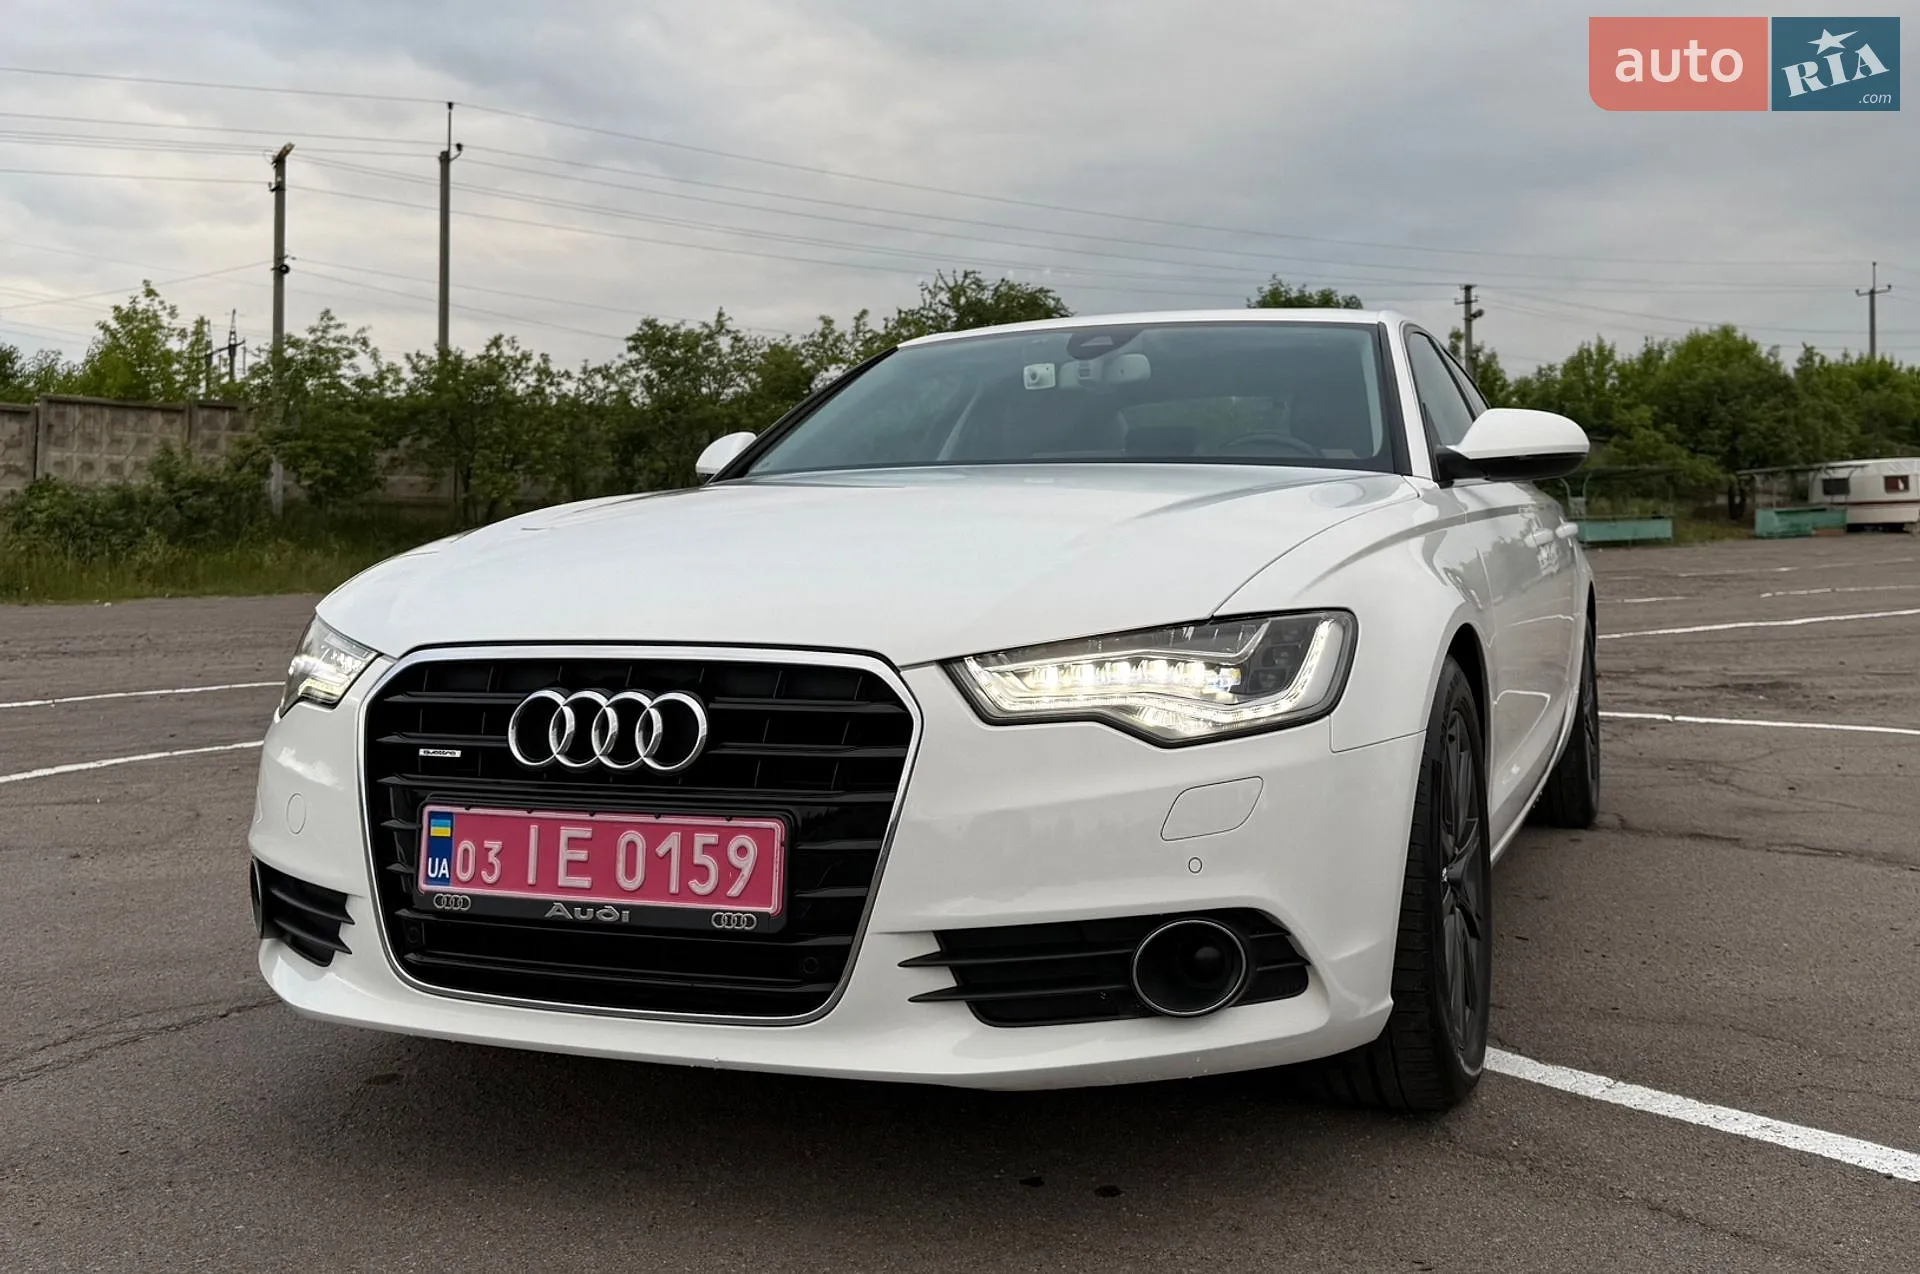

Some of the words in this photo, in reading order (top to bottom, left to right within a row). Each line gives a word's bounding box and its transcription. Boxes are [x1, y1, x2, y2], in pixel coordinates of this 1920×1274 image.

[428, 856, 450, 879] UA
[456, 840, 503, 885] 03
[527, 824, 593, 889] IE
[615, 830, 758, 898] 0159
[544, 902, 630, 924] Audi
